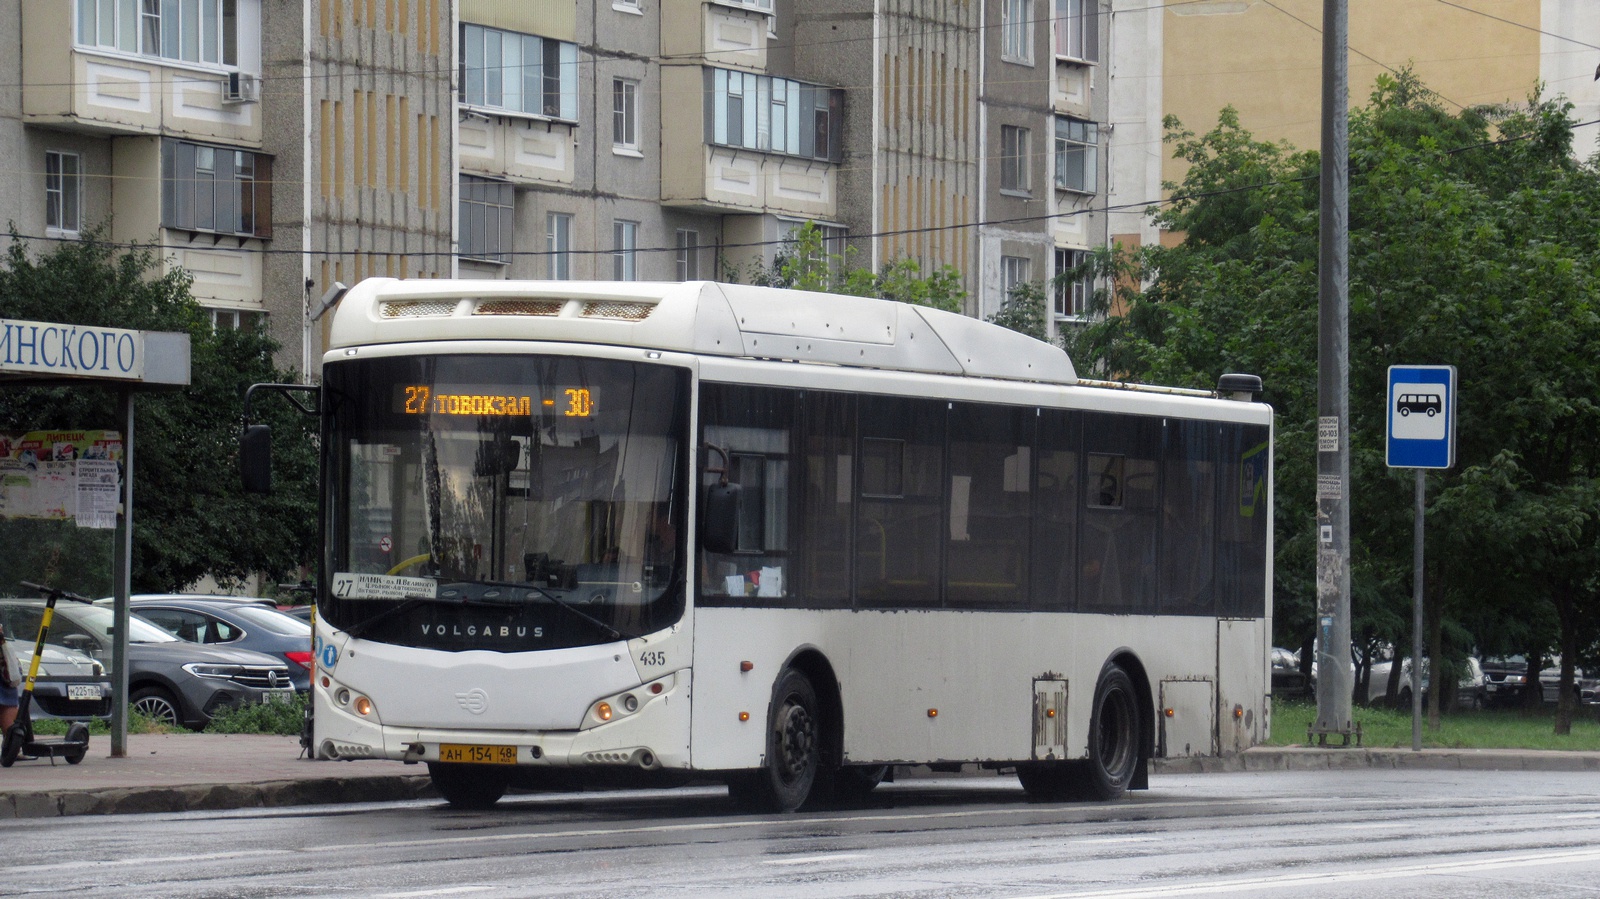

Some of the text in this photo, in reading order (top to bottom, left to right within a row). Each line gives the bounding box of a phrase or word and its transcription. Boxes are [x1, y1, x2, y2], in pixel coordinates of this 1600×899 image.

[405, 385, 429, 414] 27
[46, 433, 85, 442] ЛИПЕЦК
[337, 579, 353, 597] 27
[421, 623, 543, 638] VOLGABUS
[639, 651, 666, 666] 435
[468, 746, 492, 761] 154
[499, 747, 512, 758] 48
